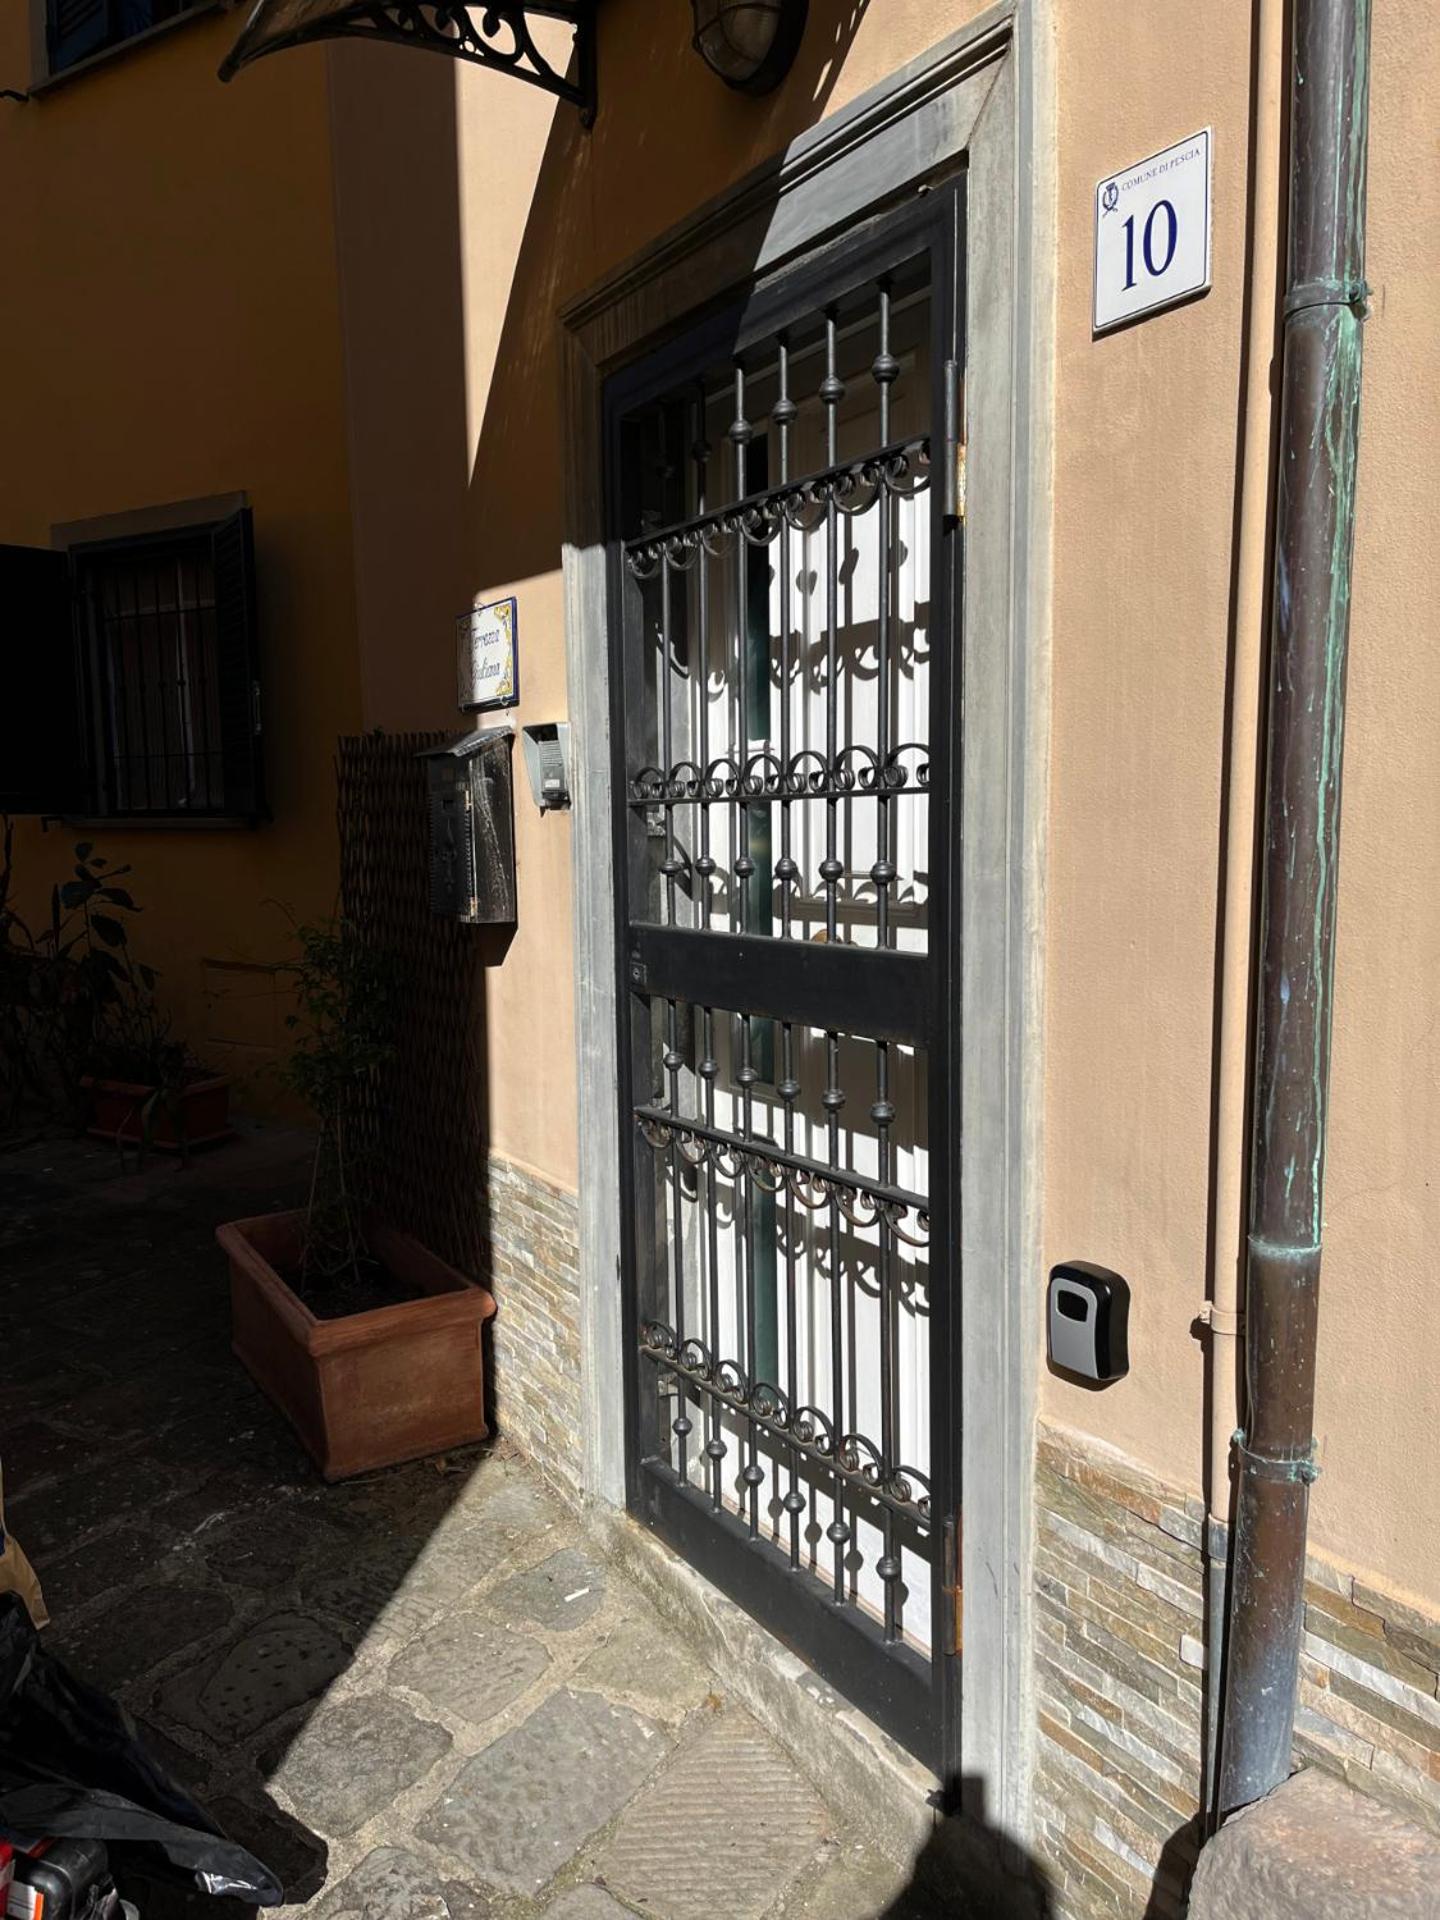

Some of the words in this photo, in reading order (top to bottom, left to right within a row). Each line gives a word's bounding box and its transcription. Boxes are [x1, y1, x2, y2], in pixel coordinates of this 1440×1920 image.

[1121, 167, 1158, 191] COMUNE
[1159, 162, 1169, 174] DI
[1170, 148, 1201, 169] PESCIA
[1121, 199, 1178, 292] 10
